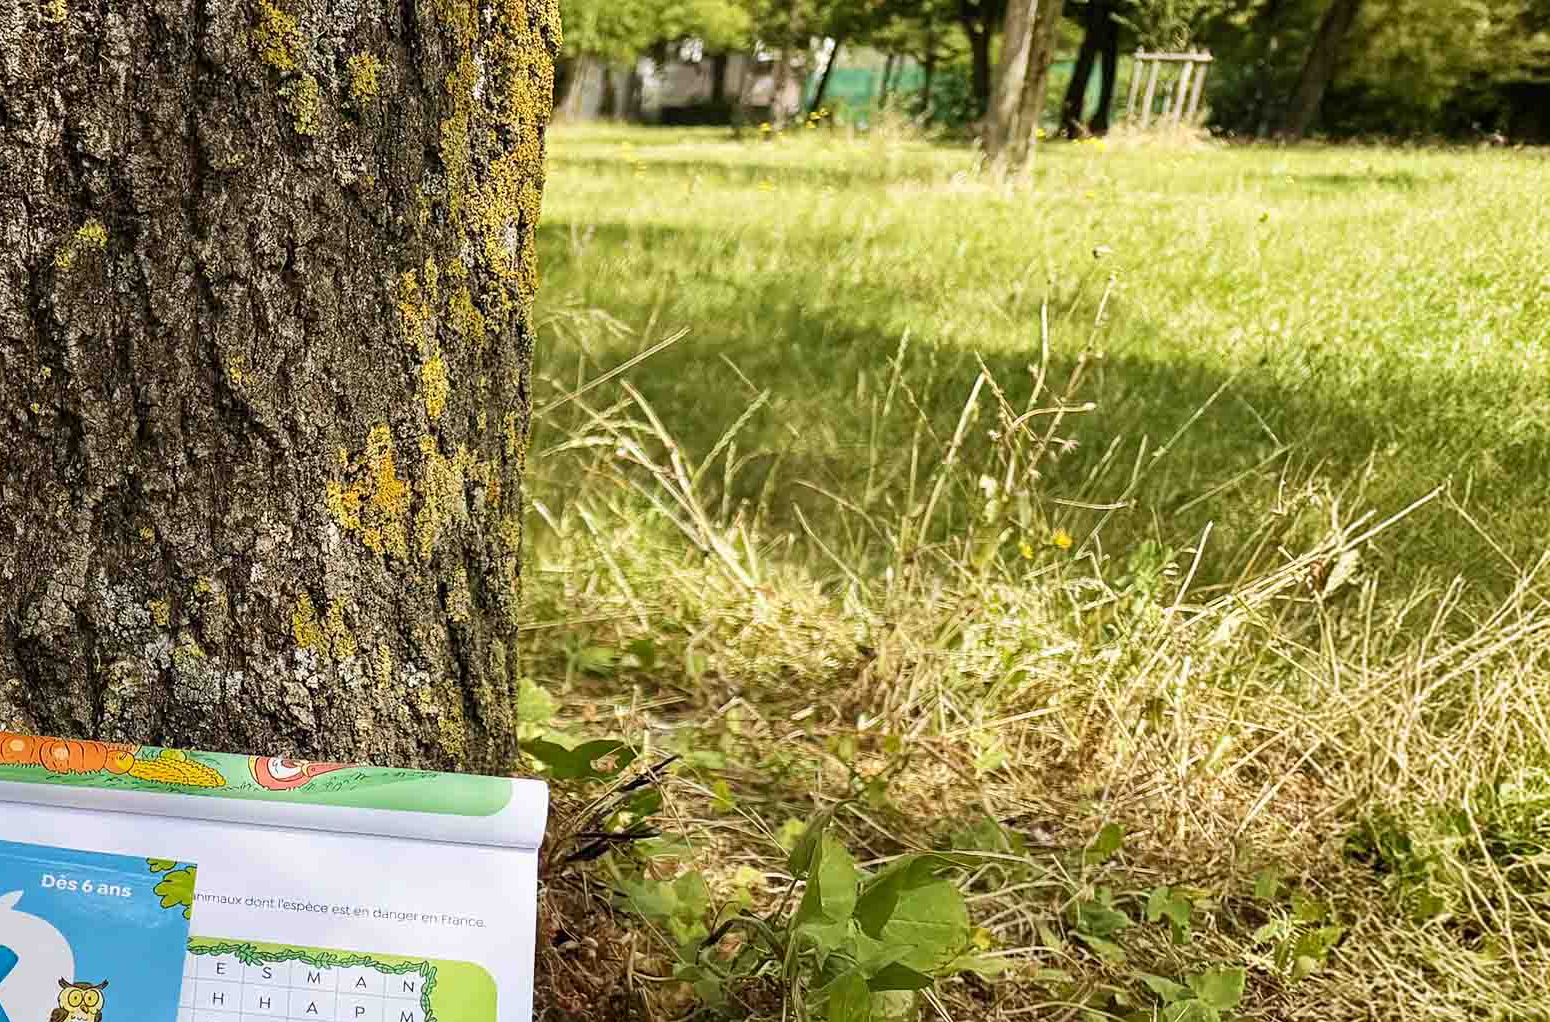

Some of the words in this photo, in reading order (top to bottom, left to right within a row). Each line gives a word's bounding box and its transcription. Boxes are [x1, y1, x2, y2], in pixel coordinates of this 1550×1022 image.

[81, 879, 93, 894] 6
[96, 883, 132, 898] ans
[245, 896, 275, 909] dont
[372, 906, 419, 922] danger
[216, 961, 227, 975] E
[261, 966, 273, 980] S
[306, 970, 321, 985] M
[354, 975, 367, 989] A
[402, 979, 415, 993] N
[212, 991, 225, 1006] H
[259, 996, 271, 1009] H
[305, 1001, 319, 1015] A
[354, 1005, 366, 1019] P
